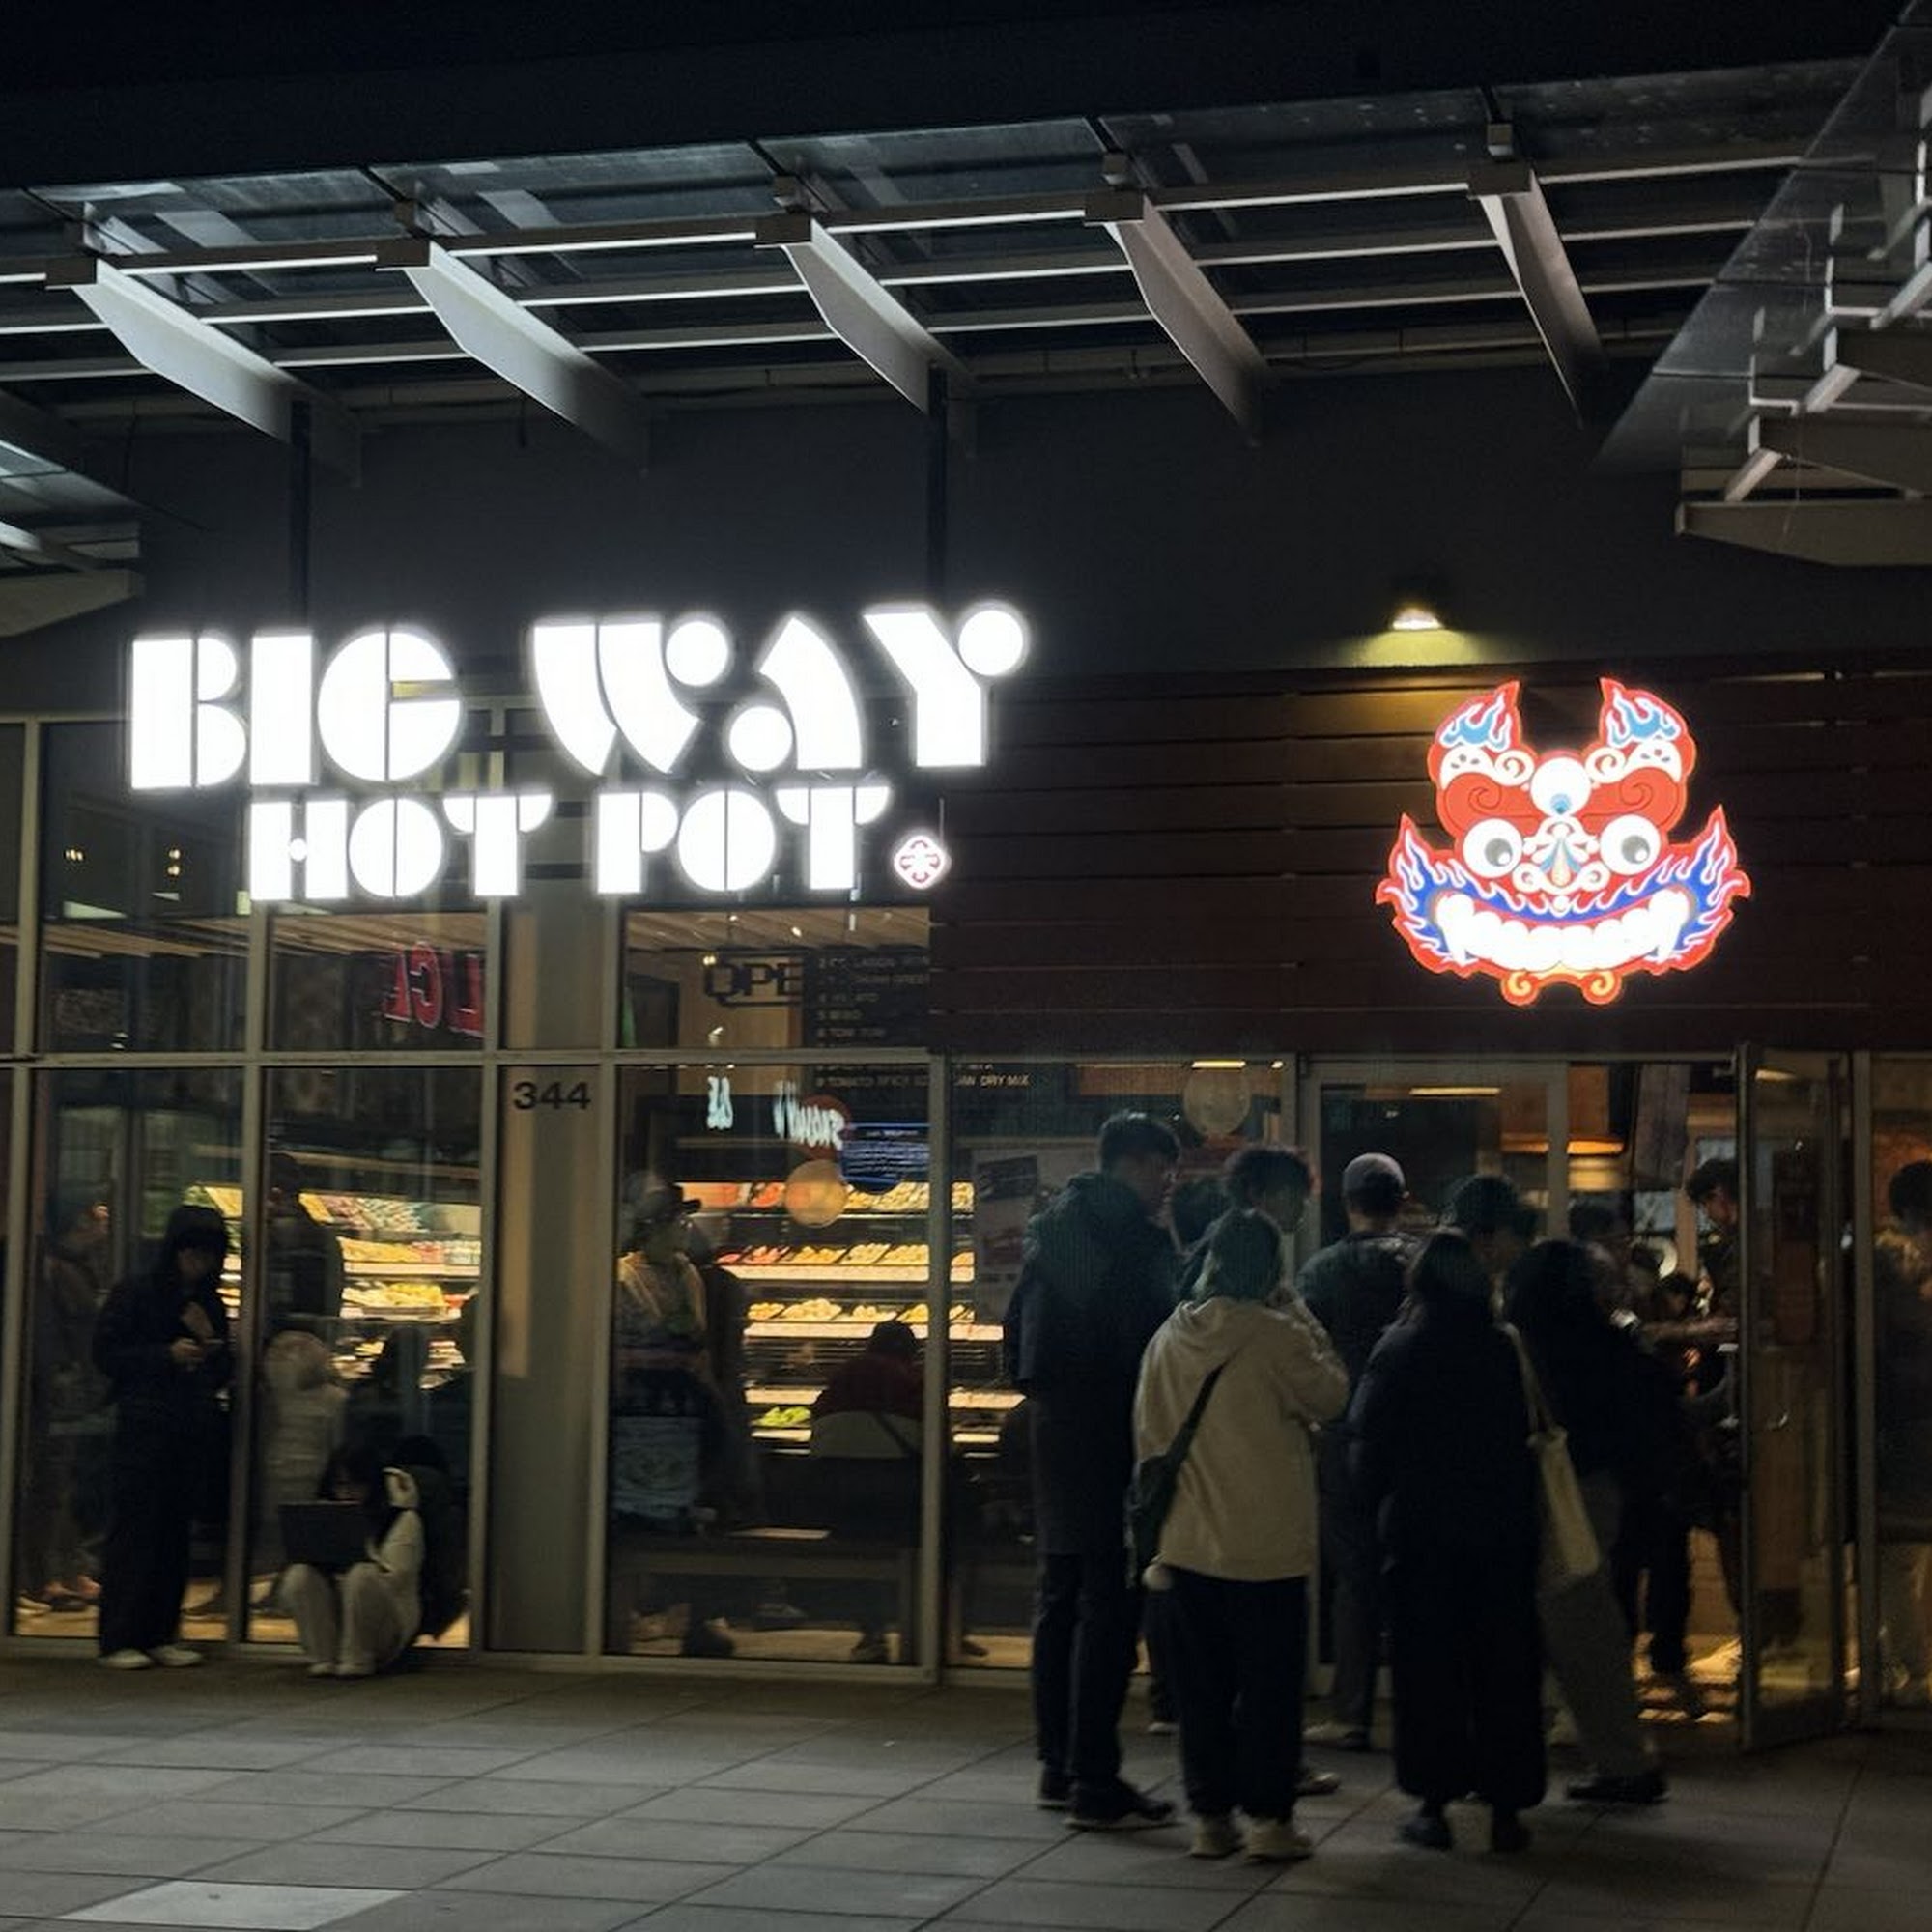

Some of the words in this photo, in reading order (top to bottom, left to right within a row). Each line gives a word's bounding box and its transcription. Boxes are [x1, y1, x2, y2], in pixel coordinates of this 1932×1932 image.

[129, 628, 463, 790] BIG
[533, 600, 1029, 778] WAY
[248, 792, 552, 903] HOT
[594, 785, 892, 898] POT
[513, 1080, 591, 1110] 344
